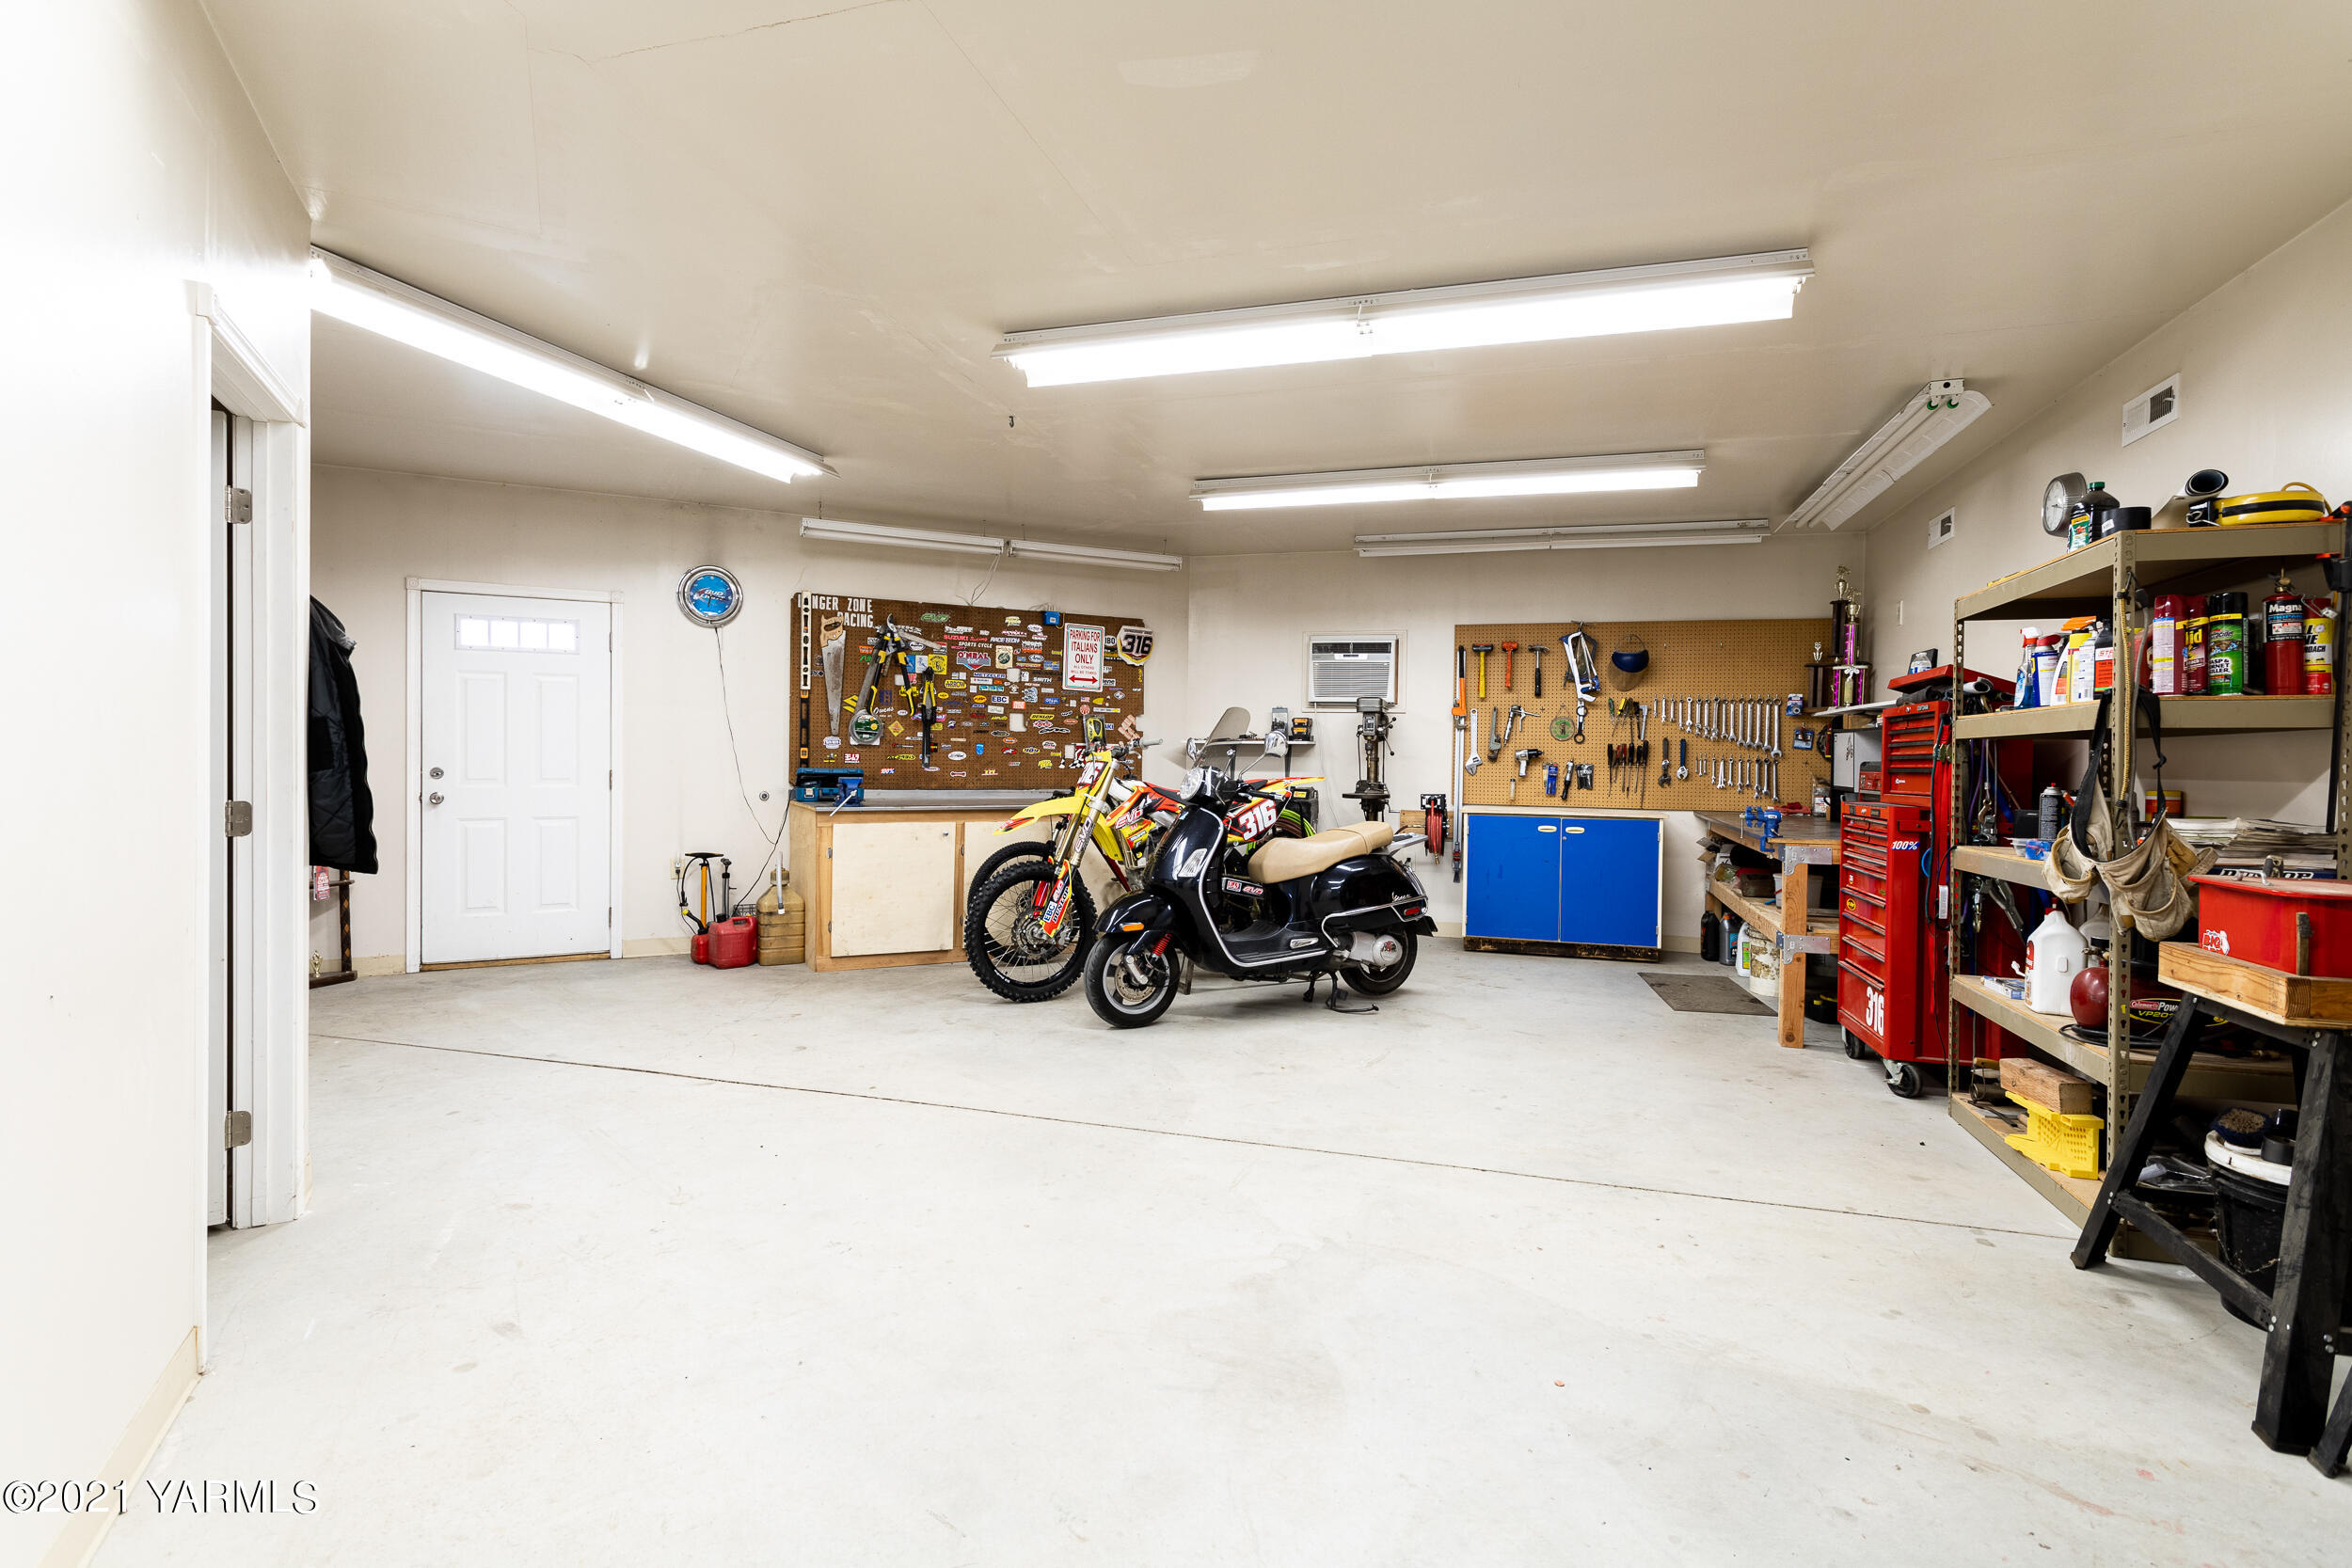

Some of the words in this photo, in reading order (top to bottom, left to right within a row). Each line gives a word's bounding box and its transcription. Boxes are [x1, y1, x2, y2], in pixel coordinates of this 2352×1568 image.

[847, 597, 873, 613] ZONE
[2268, 604, 2302, 613] Magna
[1069, 629, 1089, 641] PARKING
[1090, 631, 1101, 641] FOR
[1071, 641, 1098, 654] ITALIANS
[1121, 634, 1153, 655] 316
[1074, 654, 1094, 664] ONLY
[1116, 807, 1144, 830] EVO
[1239, 799, 1277, 841] 316
[1074, 816, 1092, 853] EVO
[1892, 840, 1919, 851] 100%
[1043, 902, 1056, 922] EBC
[1053, 886, 1071, 924] DUNLOP
[2203, 934, 2222, 948] BIG
[1866, 986, 1884, 1037] 316
